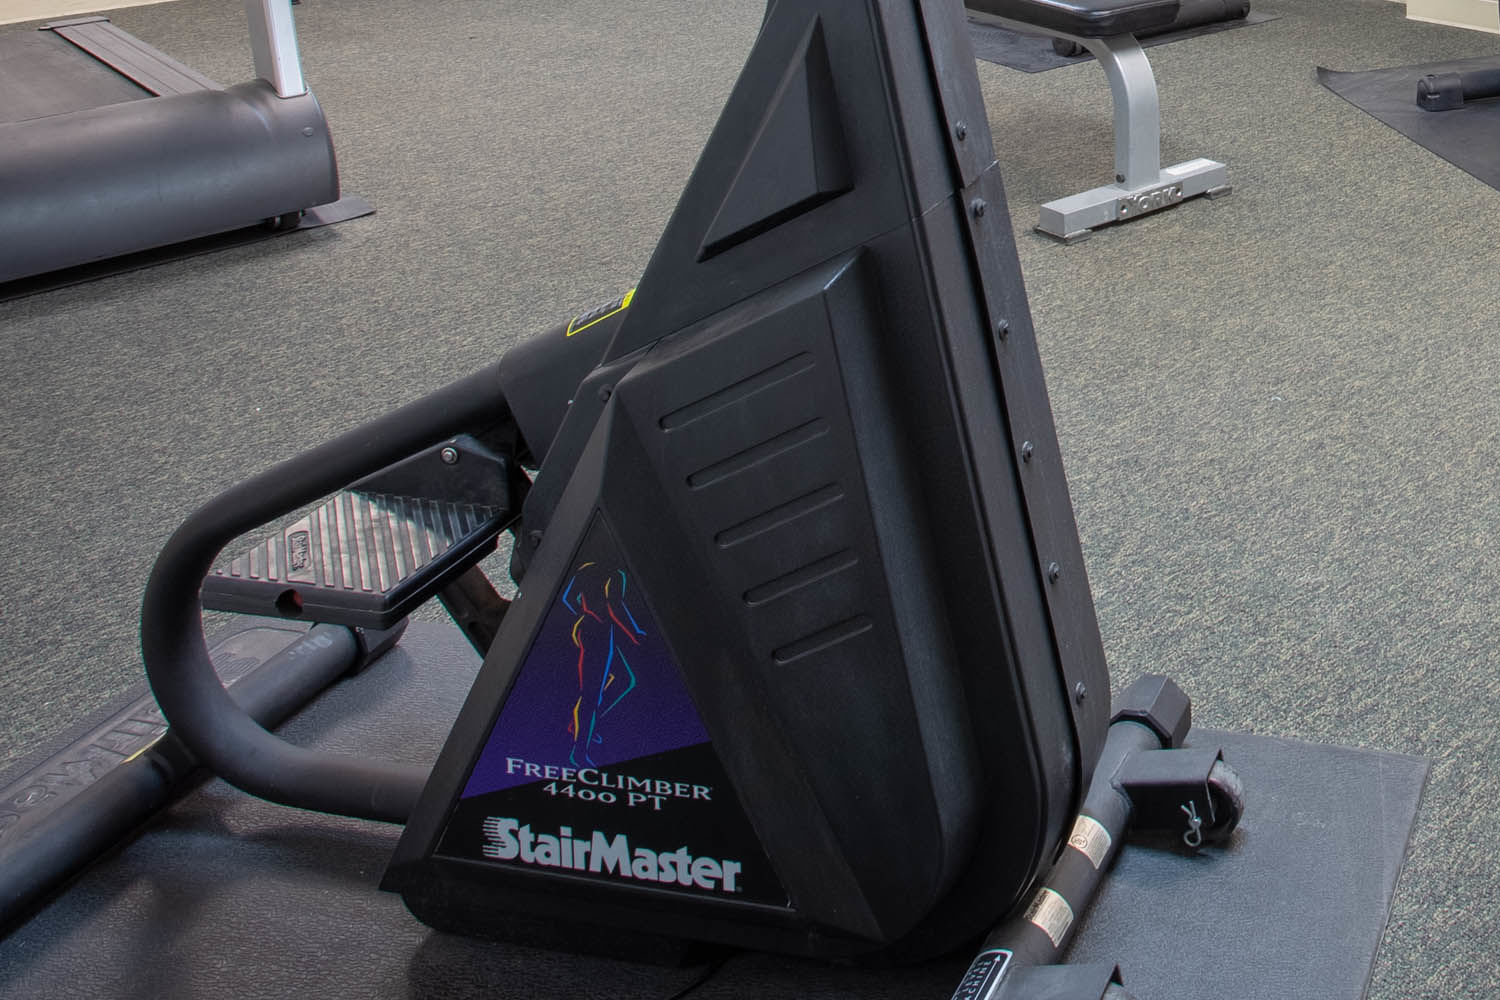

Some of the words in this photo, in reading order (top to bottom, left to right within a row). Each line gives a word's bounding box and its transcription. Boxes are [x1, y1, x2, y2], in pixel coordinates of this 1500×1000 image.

[1127, 186, 1177, 214] YORK
[543, 781, 617, 806] 4400
[628, 791, 667, 811] PT
[482, 816, 742, 892] StairMaster
[964, 961, 992, 1000] ACHINE
